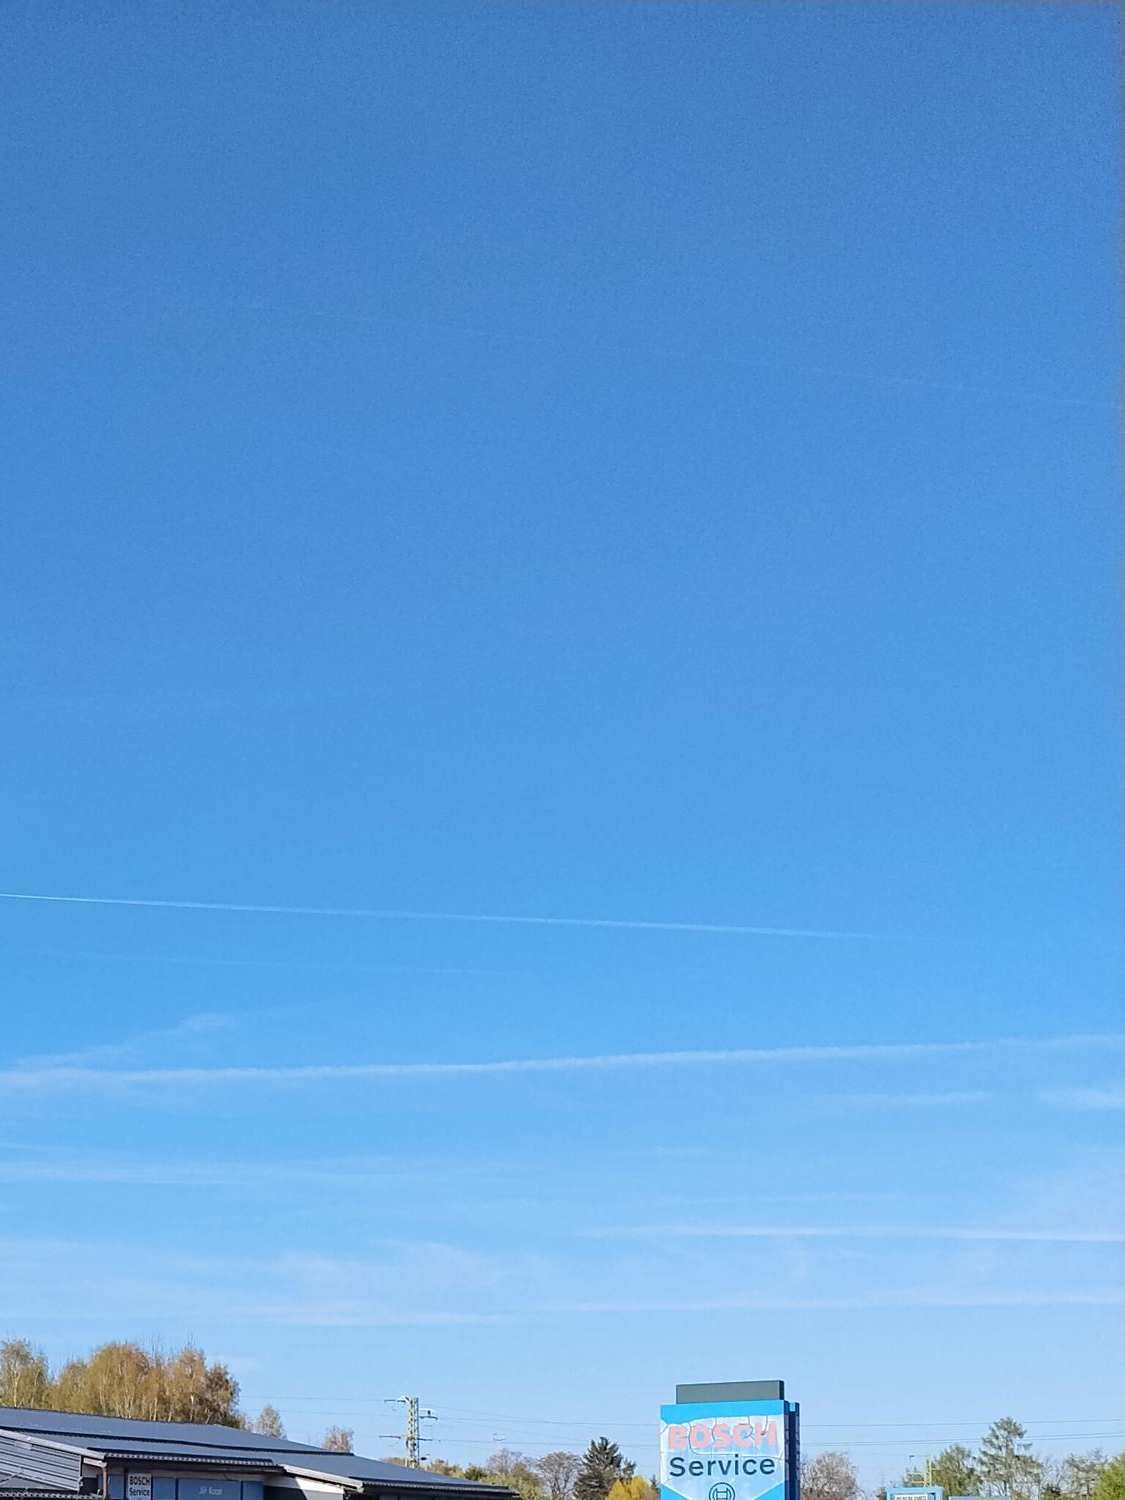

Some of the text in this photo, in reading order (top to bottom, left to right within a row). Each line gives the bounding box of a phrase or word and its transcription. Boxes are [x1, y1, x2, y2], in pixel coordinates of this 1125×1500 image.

[668, 1422, 777, 1449] BOSCH
[669, 1454, 775, 1477] Service
[129, 1475, 151, 1485] BOSCH
[129, 1487, 151, 1497] Service
